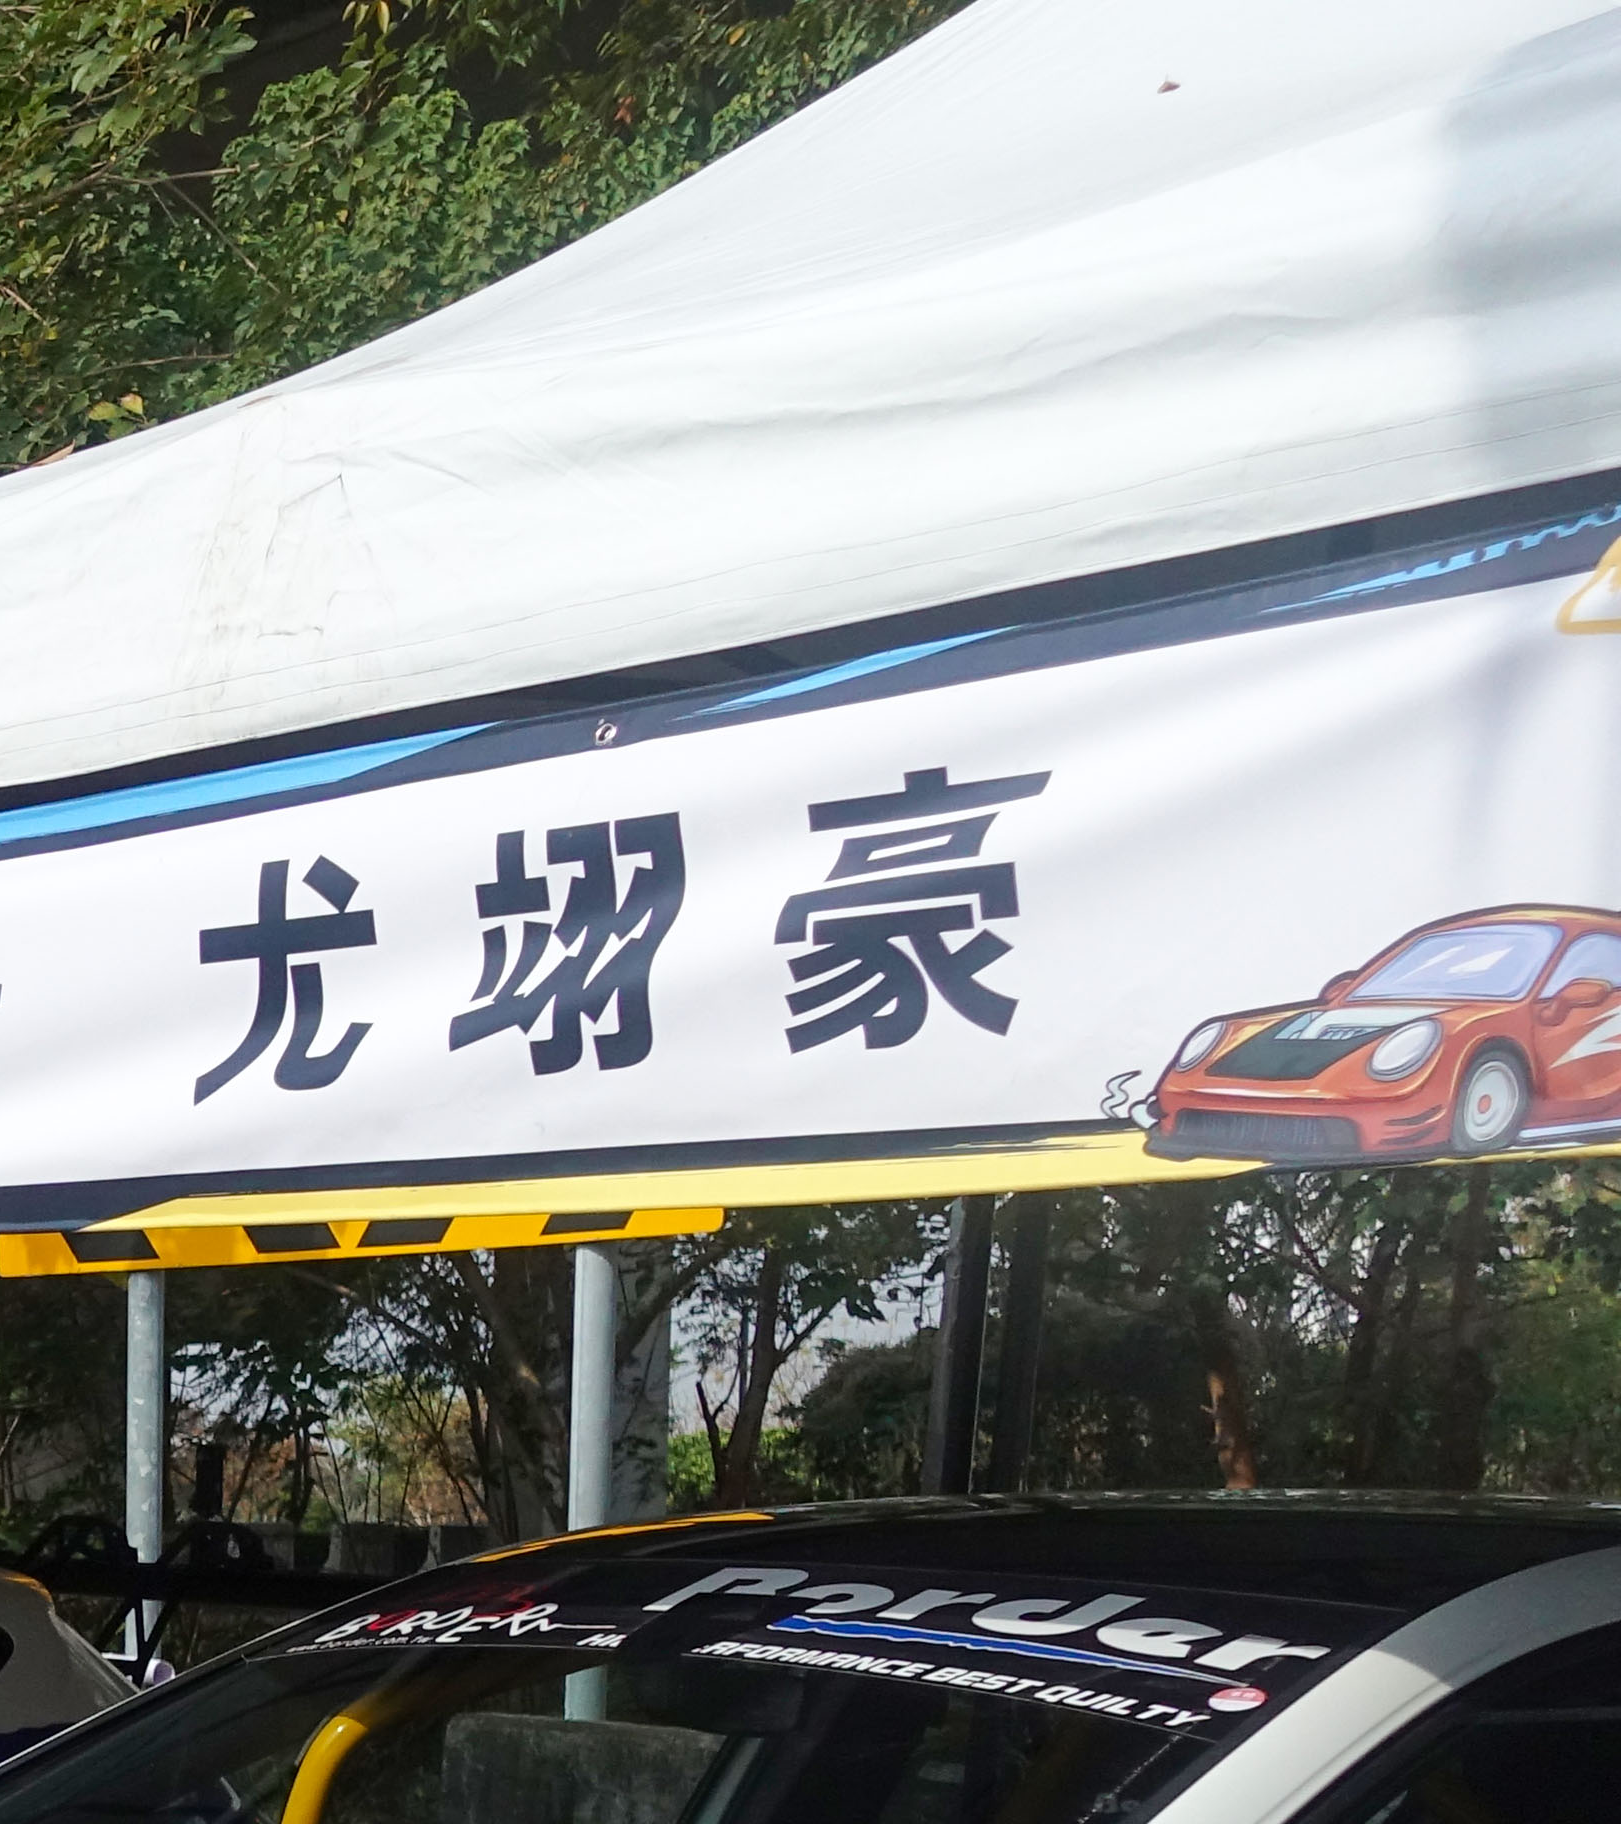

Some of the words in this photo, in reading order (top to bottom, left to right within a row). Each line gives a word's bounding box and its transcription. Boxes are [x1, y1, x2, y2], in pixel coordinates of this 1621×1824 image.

[194, 765, 1053, 1104] 尤翊豪
[577, 1632, 627, 1648] HI
[643, 1566, 1331, 1668] Border
[921, 1662, 1041, 1695] BEST
[1034, 1680, 1210, 1728] QUILTY
